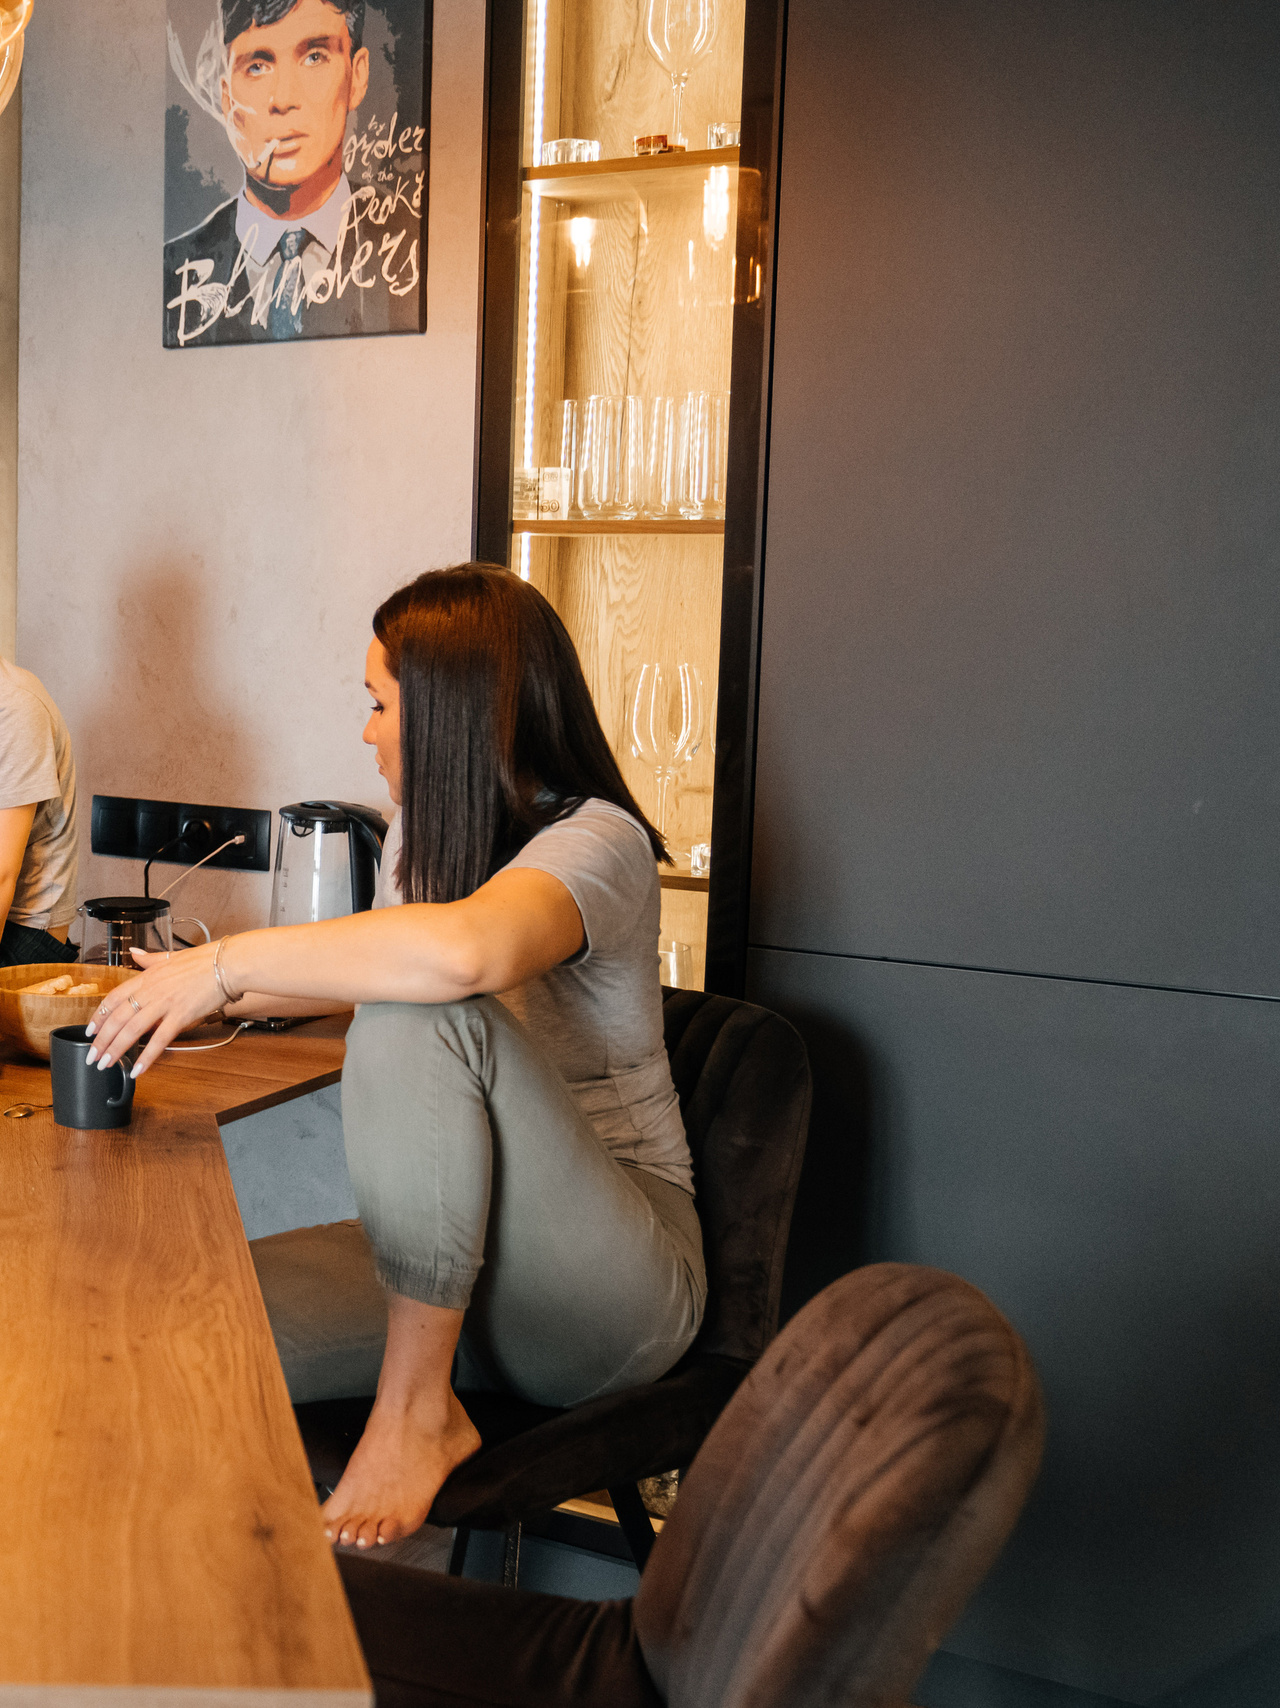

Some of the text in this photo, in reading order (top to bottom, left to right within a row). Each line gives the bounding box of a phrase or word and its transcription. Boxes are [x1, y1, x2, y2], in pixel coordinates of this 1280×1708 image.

[343, 111, 426, 173] order
[368, 114, 386, 136] by
[340, 170, 425, 236] Peaky
[361, 164, 395, 183] of the
[166, 211, 420, 347] Blinders
